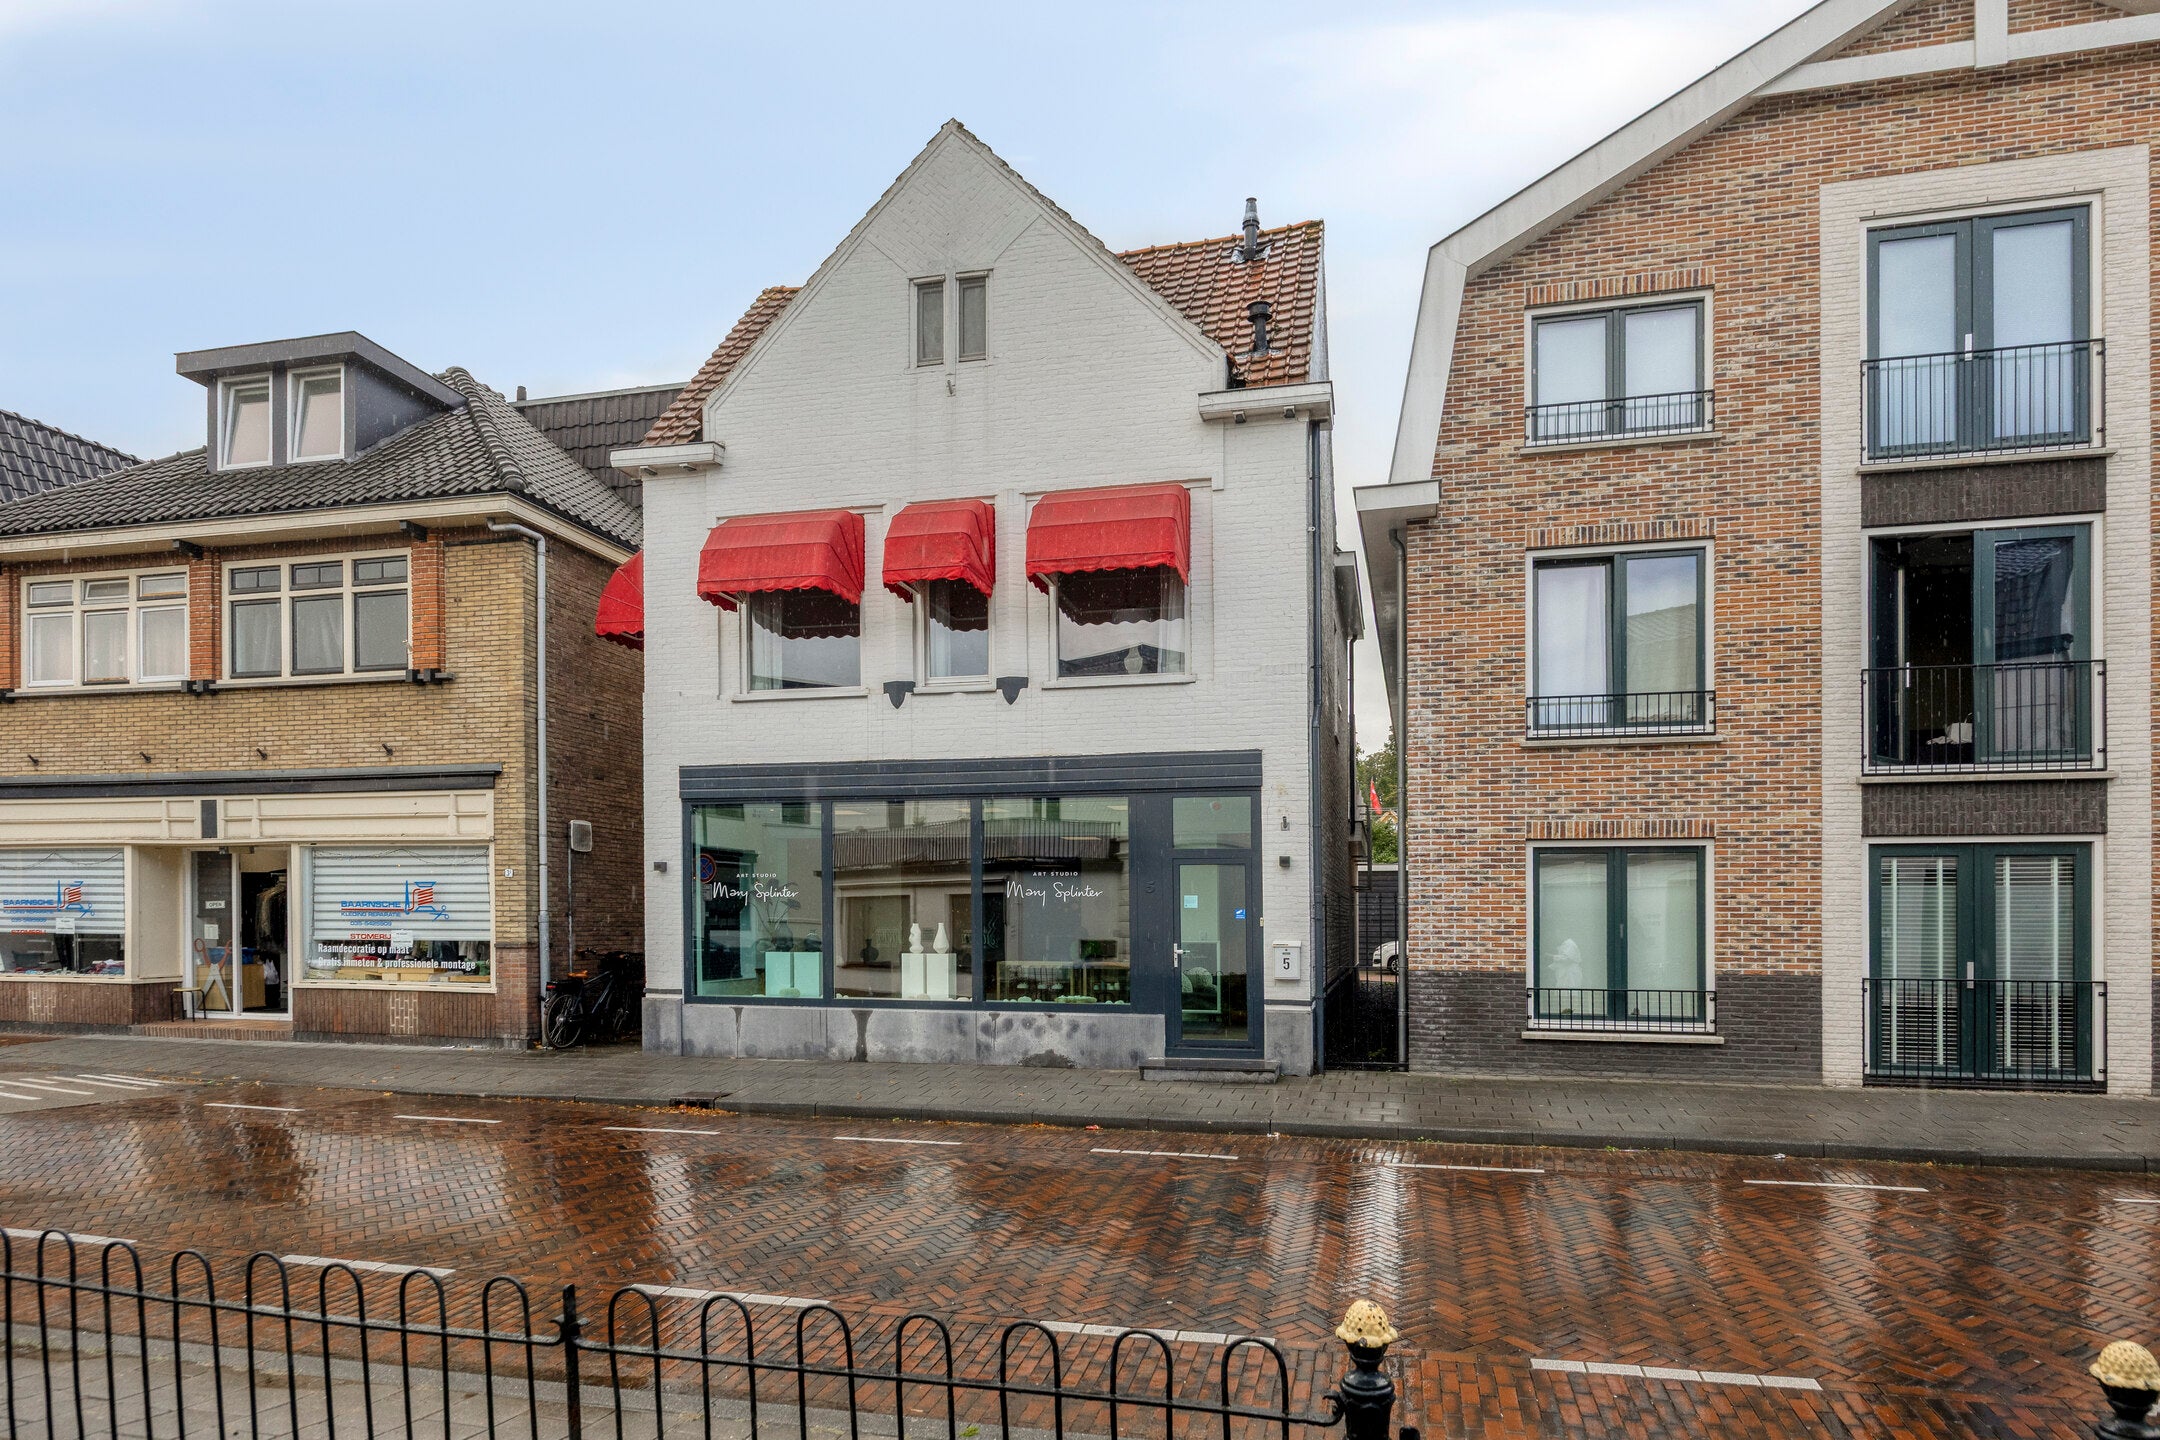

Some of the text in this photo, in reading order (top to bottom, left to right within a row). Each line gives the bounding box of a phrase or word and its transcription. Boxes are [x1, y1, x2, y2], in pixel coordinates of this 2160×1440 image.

[754, 882, 800, 903] Splinter
[1053, 881, 1103, 903] Splinter
[340, 900, 401, 908] BAARNSCHE
[317, 943, 410, 956] Raamdecoratie op maat
[318, 957, 477, 971] Gratis inmeten & professionele montage
[1283, 957, 1290, 970] 5
